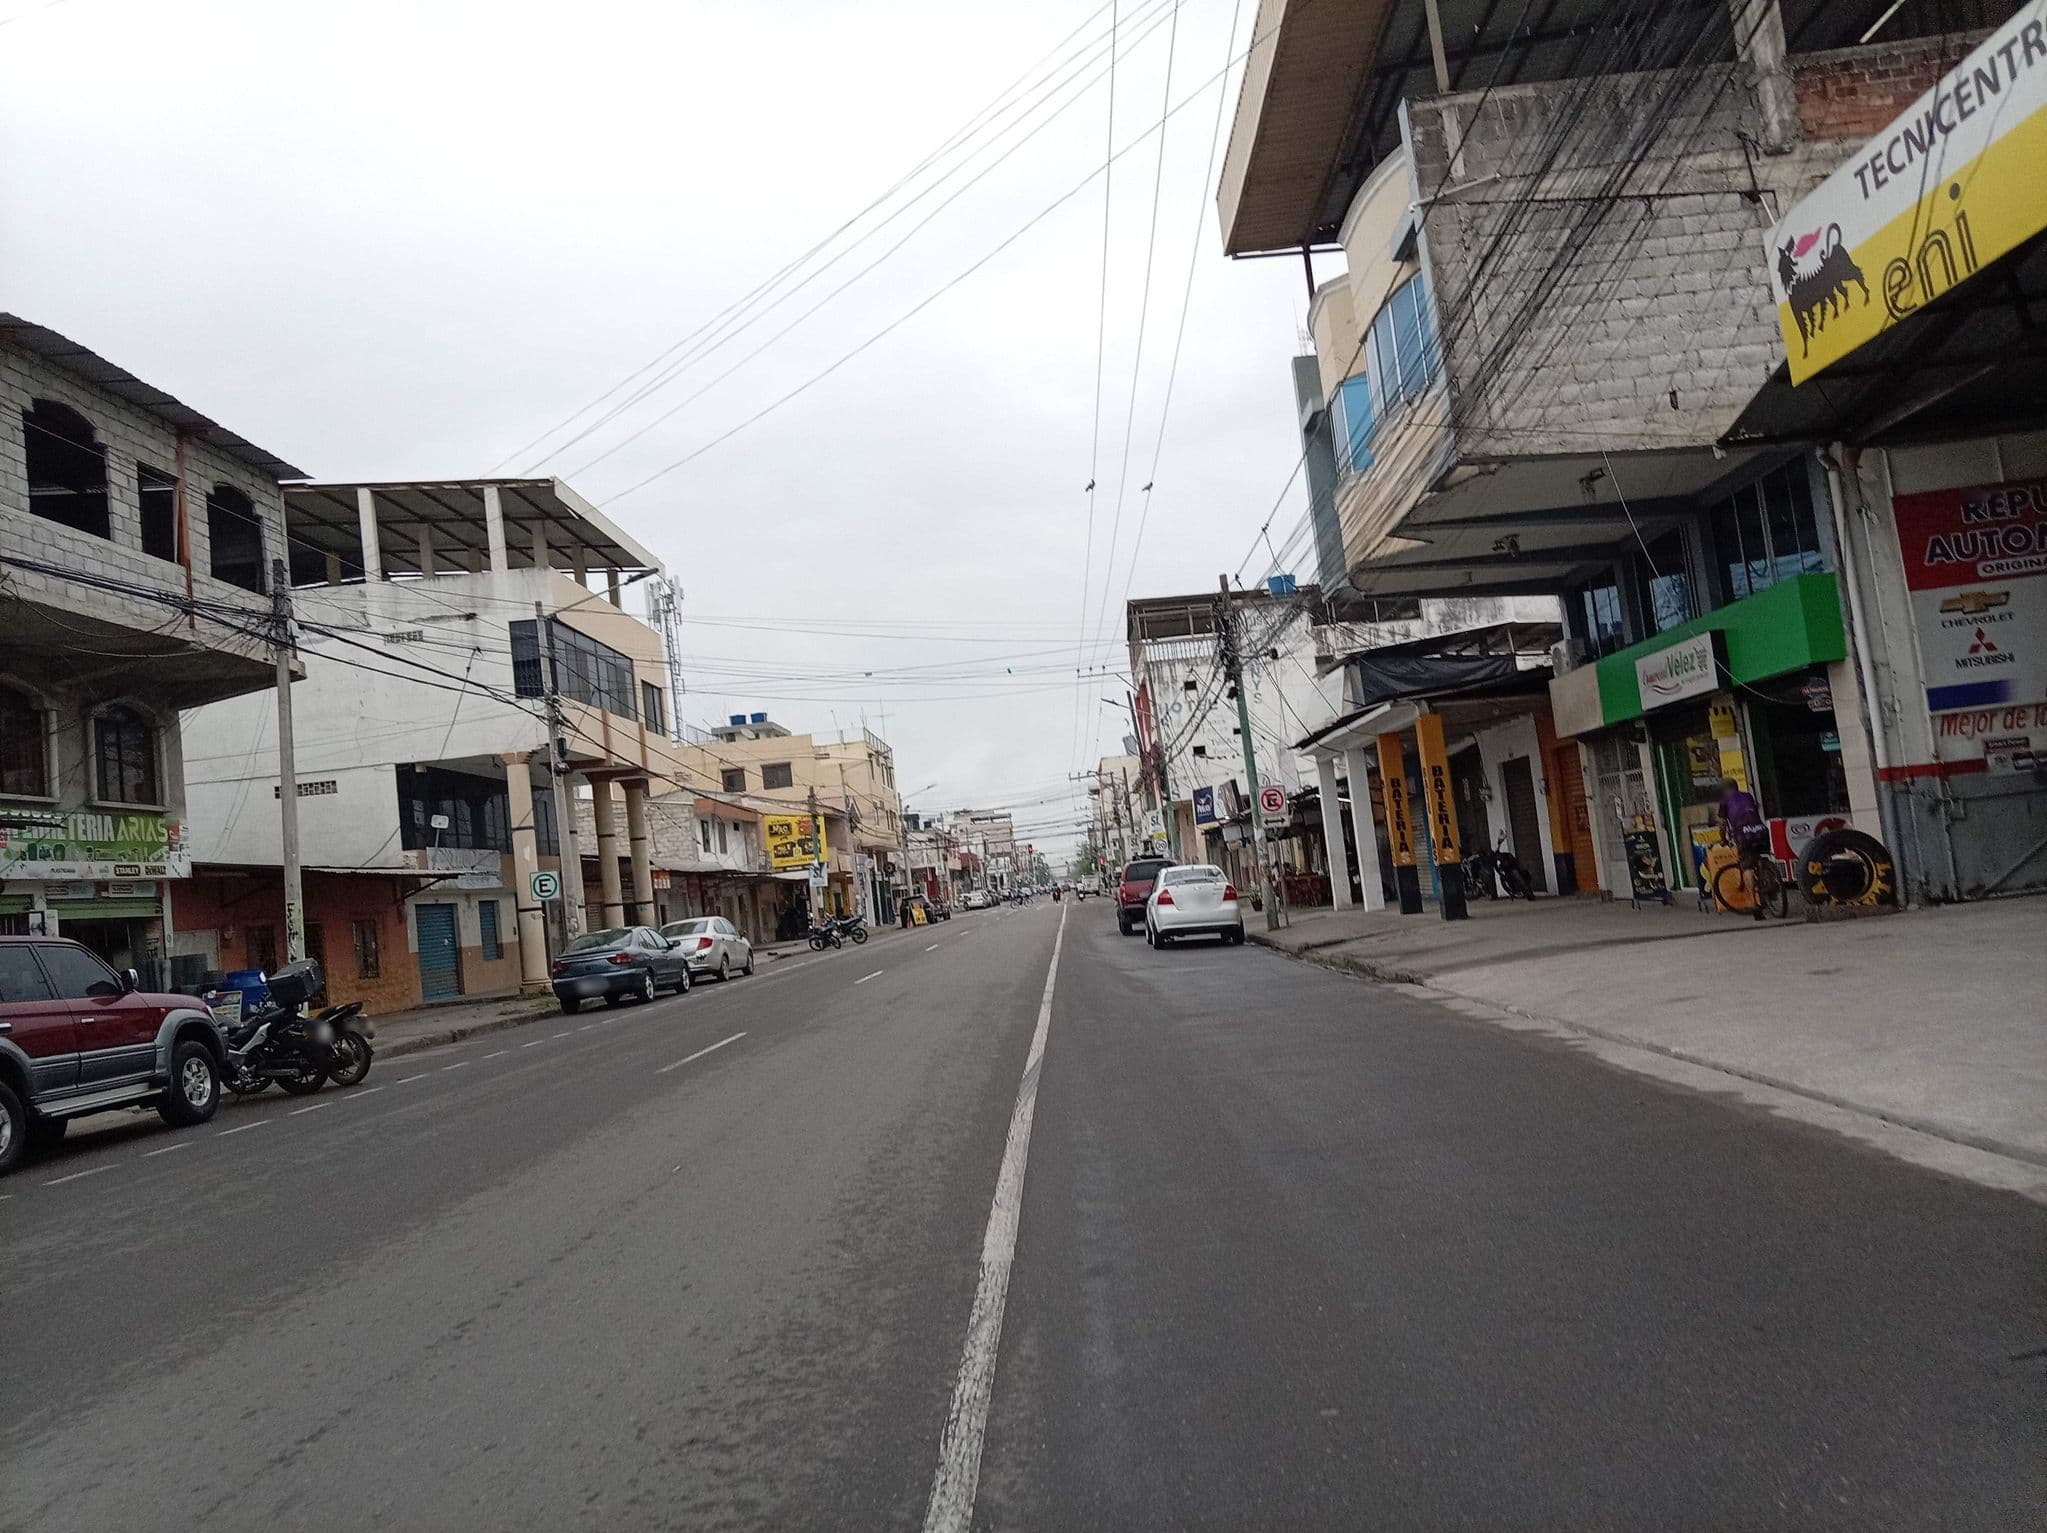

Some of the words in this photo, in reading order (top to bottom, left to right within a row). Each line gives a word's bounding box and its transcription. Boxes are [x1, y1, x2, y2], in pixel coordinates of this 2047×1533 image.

[1854, 18, 2047, 200] TECNICENTR
[1883, 182, 1979, 322] eni
[1941, 612, 2014, 629] CHEVROLET
[1955, 651, 2016, 669] MITSUBISHI
[117, 816, 169, 843] ARIAS
[538, 878, 551, 893] E
